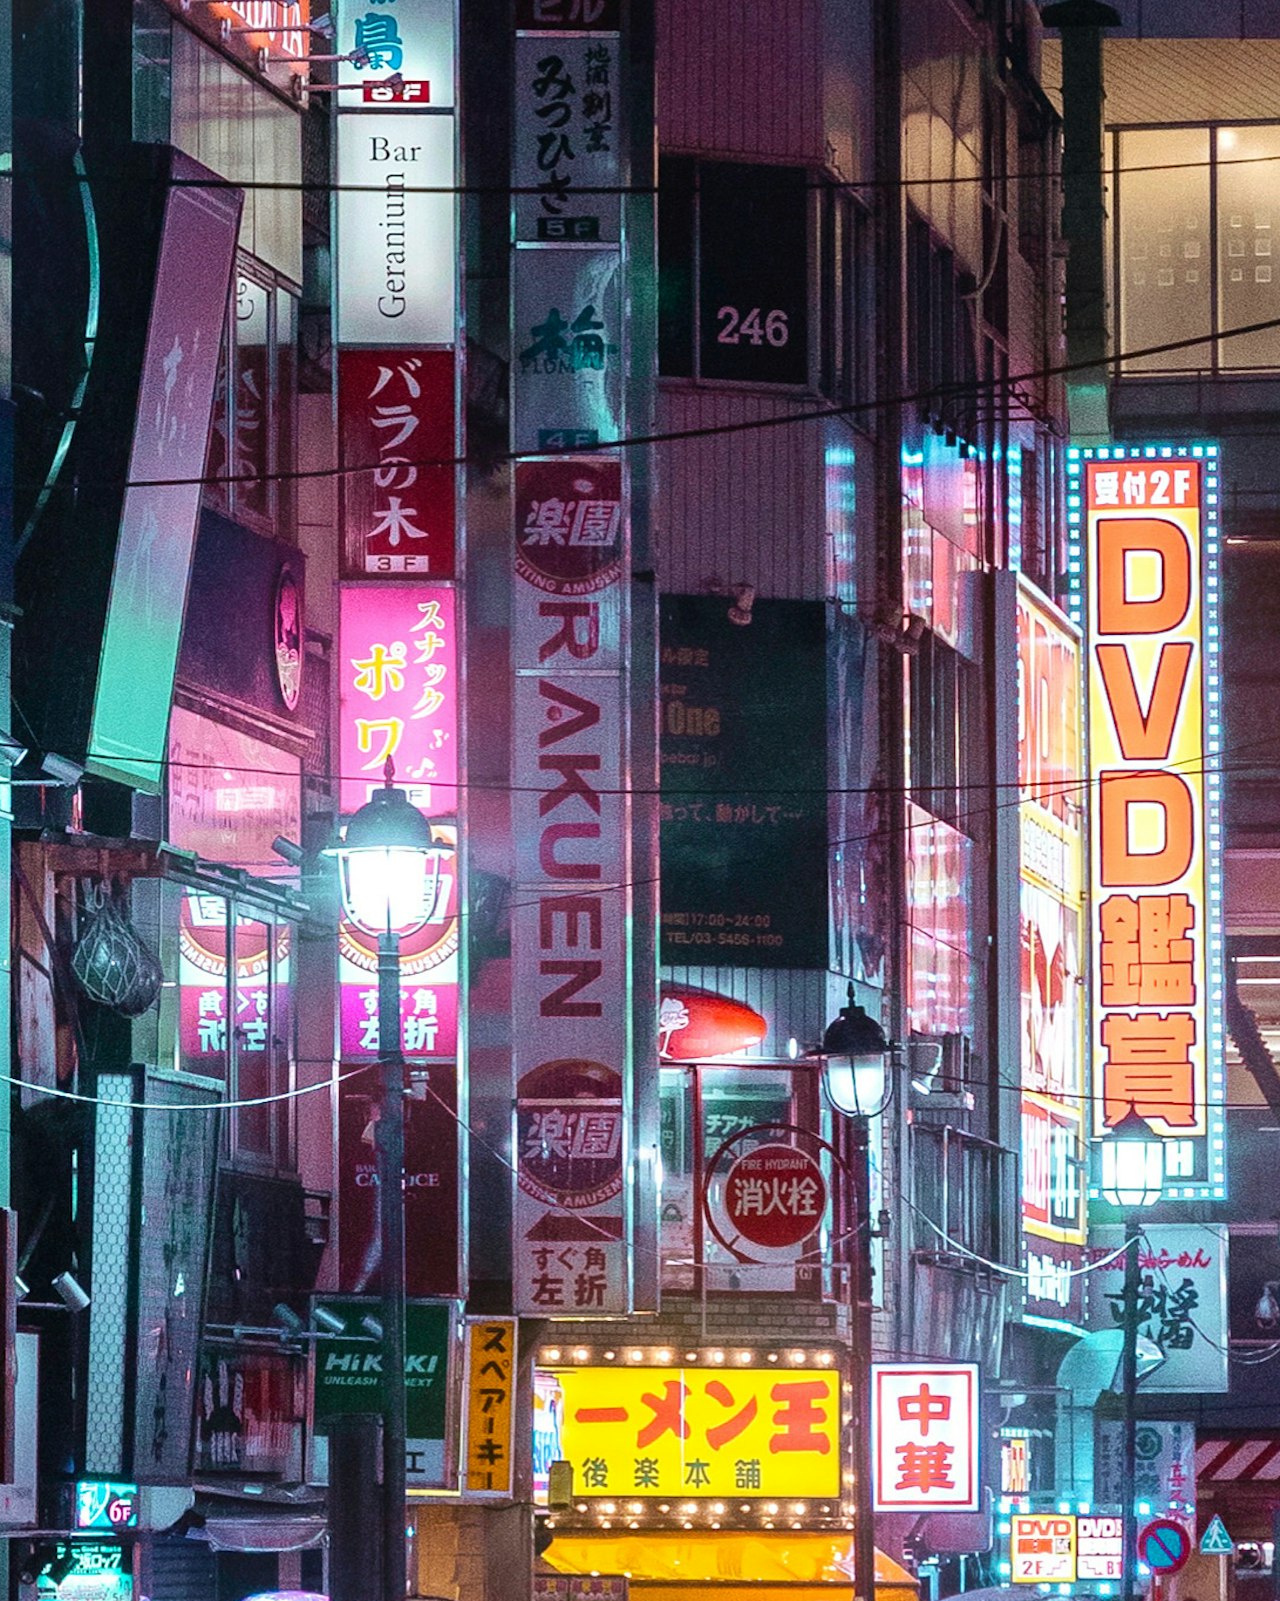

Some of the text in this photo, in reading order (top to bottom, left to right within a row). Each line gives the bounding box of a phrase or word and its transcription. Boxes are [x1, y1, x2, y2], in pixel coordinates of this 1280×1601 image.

[368, 136, 423, 163] Bar
[532, 54, 577, 215] みつひさ
[377, 172, 406, 320] Geranium
[716, 306, 789, 347] 246
[365, 357, 429, 547] バラの木
[1094, 470, 1192, 505] 受付2F
[521, 496, 621, 547] 楽園
[376, 556, 419, 572] 3F
[408, 598, 446, 722] スナック
[538, 601, 602, 1018] RAKUEN
[523, 1108, 621, 1159] 楽園
[740, 1158, 810, 1171] FIRE HYDRANT
[734, 1177, 819, 1217] 消火栓
[531, 1245, 607, 1272] すぐ角
[530, 1272, 608, 1306] 左折
[323, 1376, 378, 1386] UNLEASH
[324, 1352, 440, 1374] HiKKI
[479, 1326, 511, 1491] スペアーキー
[574, 1379, 830, 1455] ーメン王
[895, 1382, 956, 1493] 中華
[581, 1457, 762, 1489] 後楽本舗
[108, 1501, 132, 1523] 6F
[1017, 1519, 1072, 1536] DVD
[1022, 1560, 1044, 1576] 2F
